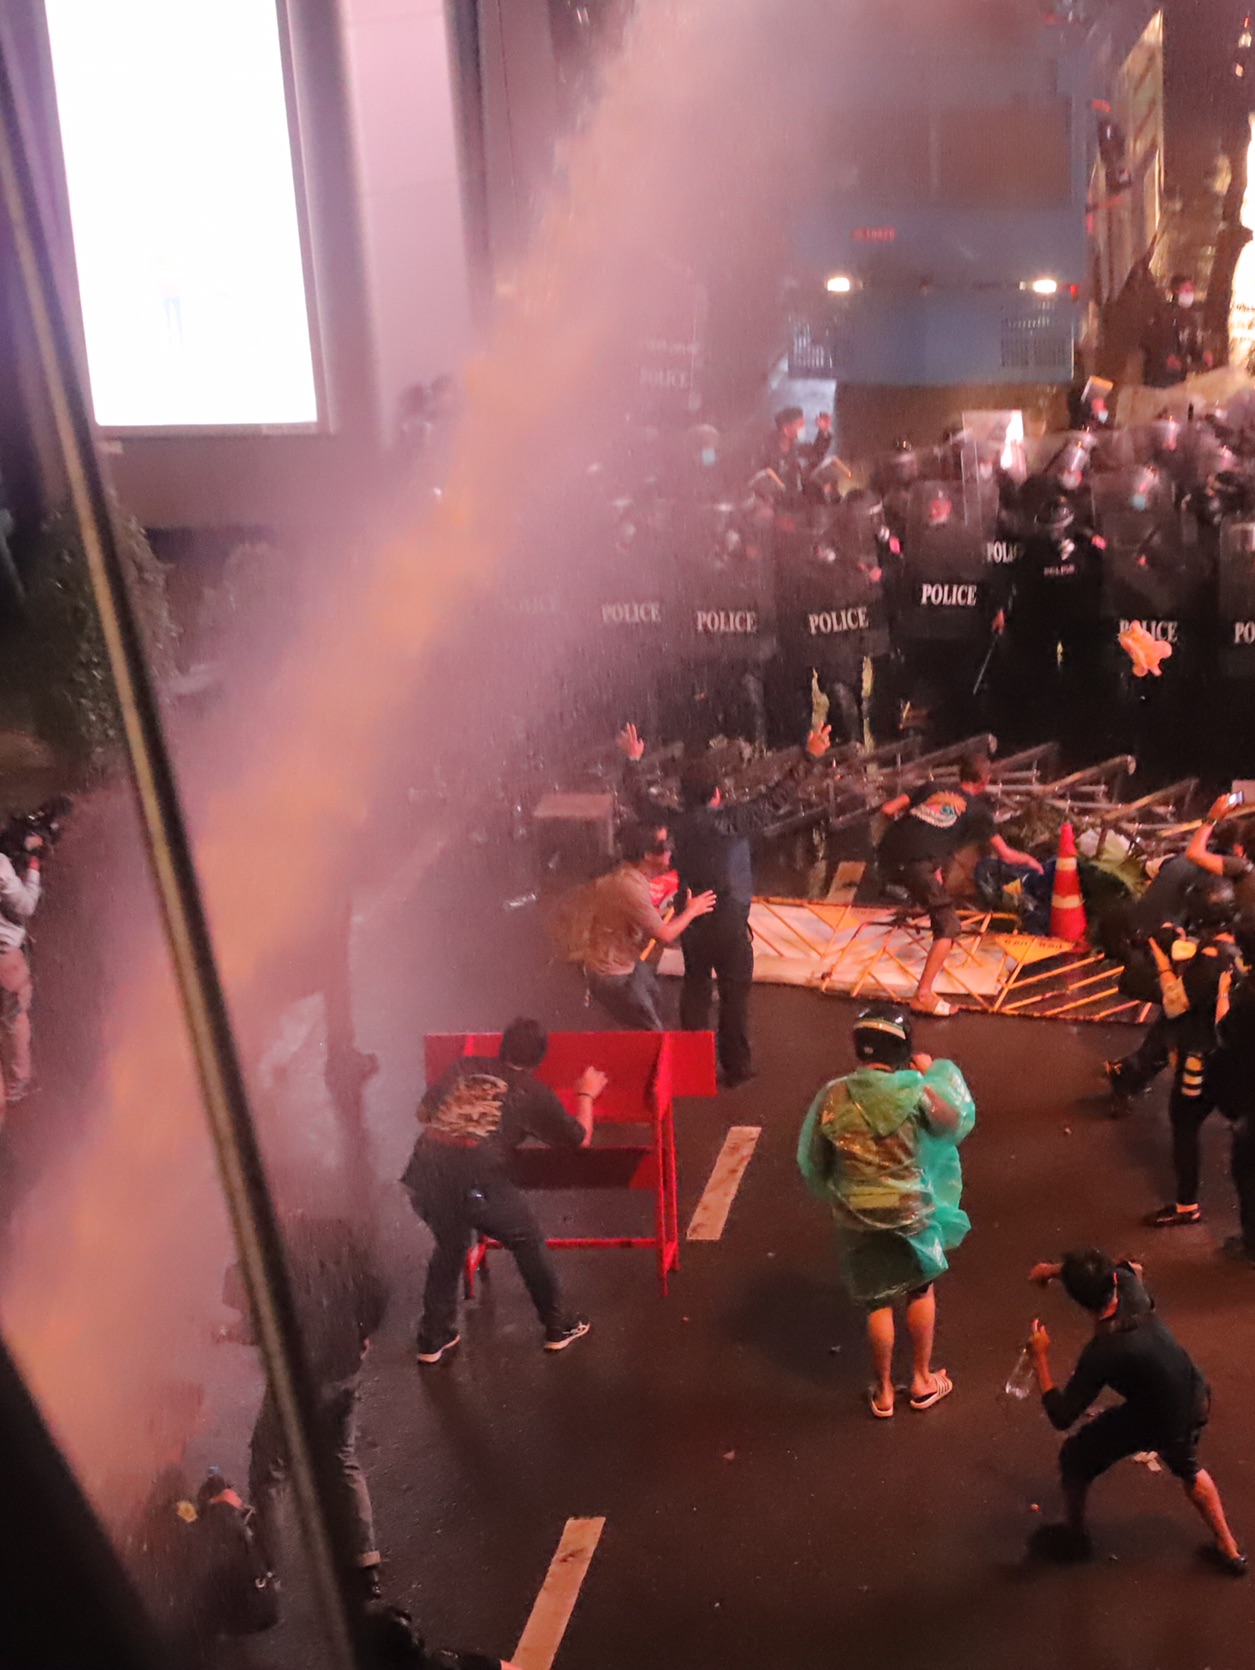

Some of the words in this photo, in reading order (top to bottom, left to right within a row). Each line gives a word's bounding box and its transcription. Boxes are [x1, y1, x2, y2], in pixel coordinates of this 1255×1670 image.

[986, 541, 1018, 563] POLI
[921, 583, 977, 606] POLICE
[601, 602, 661, 623] POLICE
[697, 610, 757, 633] POLICE
[808, 606, 869, 635] POLICE
[1118, 619, 1178, 642] PICE
